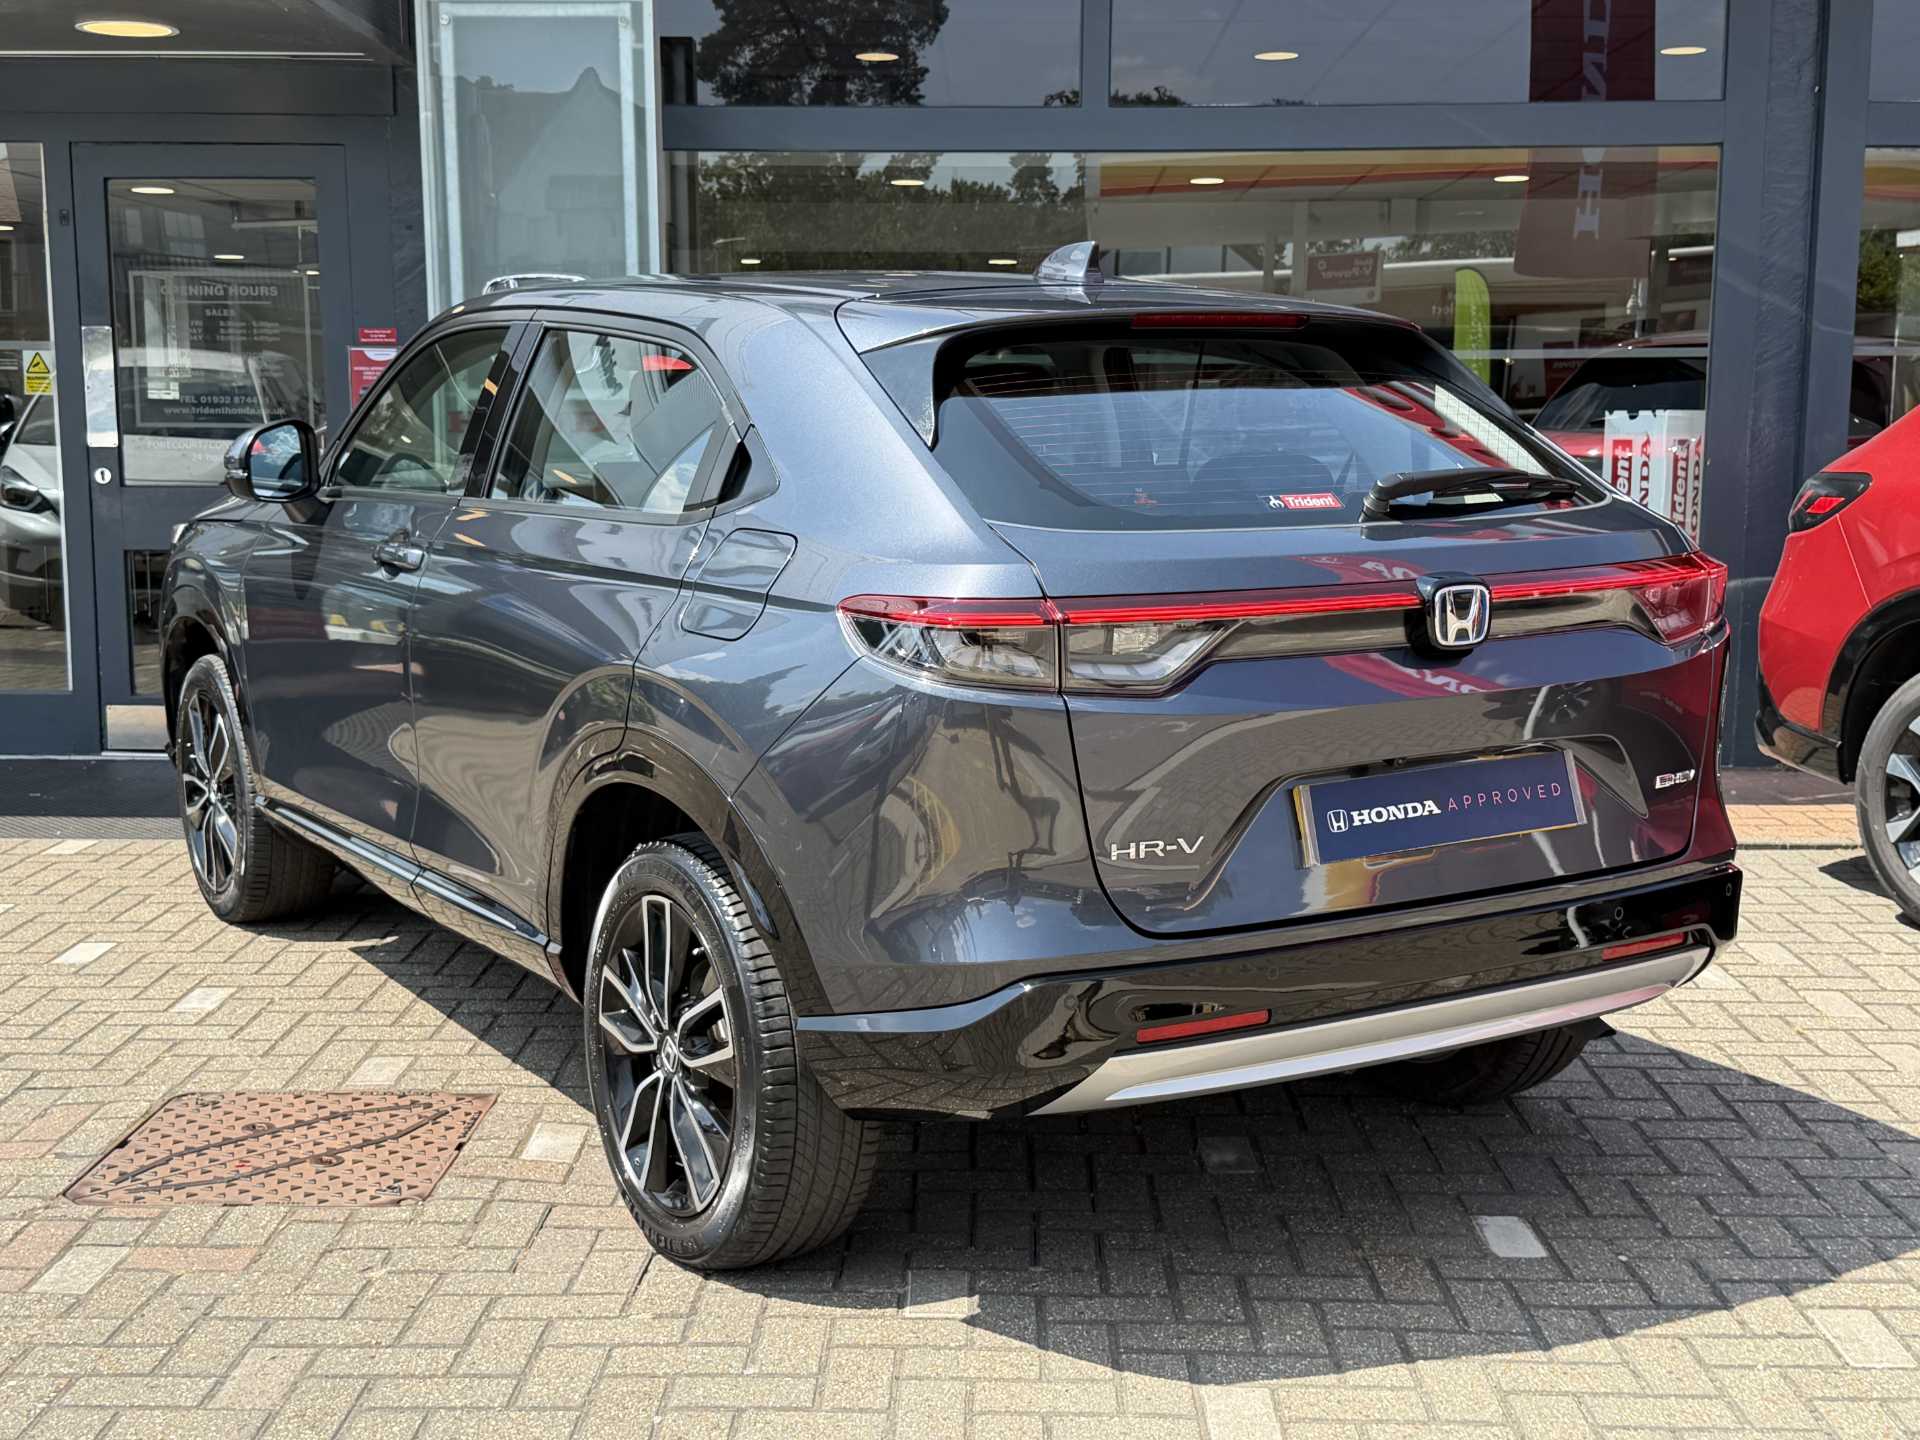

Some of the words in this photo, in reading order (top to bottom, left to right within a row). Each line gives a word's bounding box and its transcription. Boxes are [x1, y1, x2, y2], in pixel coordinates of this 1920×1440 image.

[228, 285, 279, 297] HOURS
[1284, 495, 1336, 508] Trident
[1350, 800, 1441, 826] HONDA
[1448, 782, 1561, 812] APPROVED
[1110, 836, 1204, 861] HR-V
